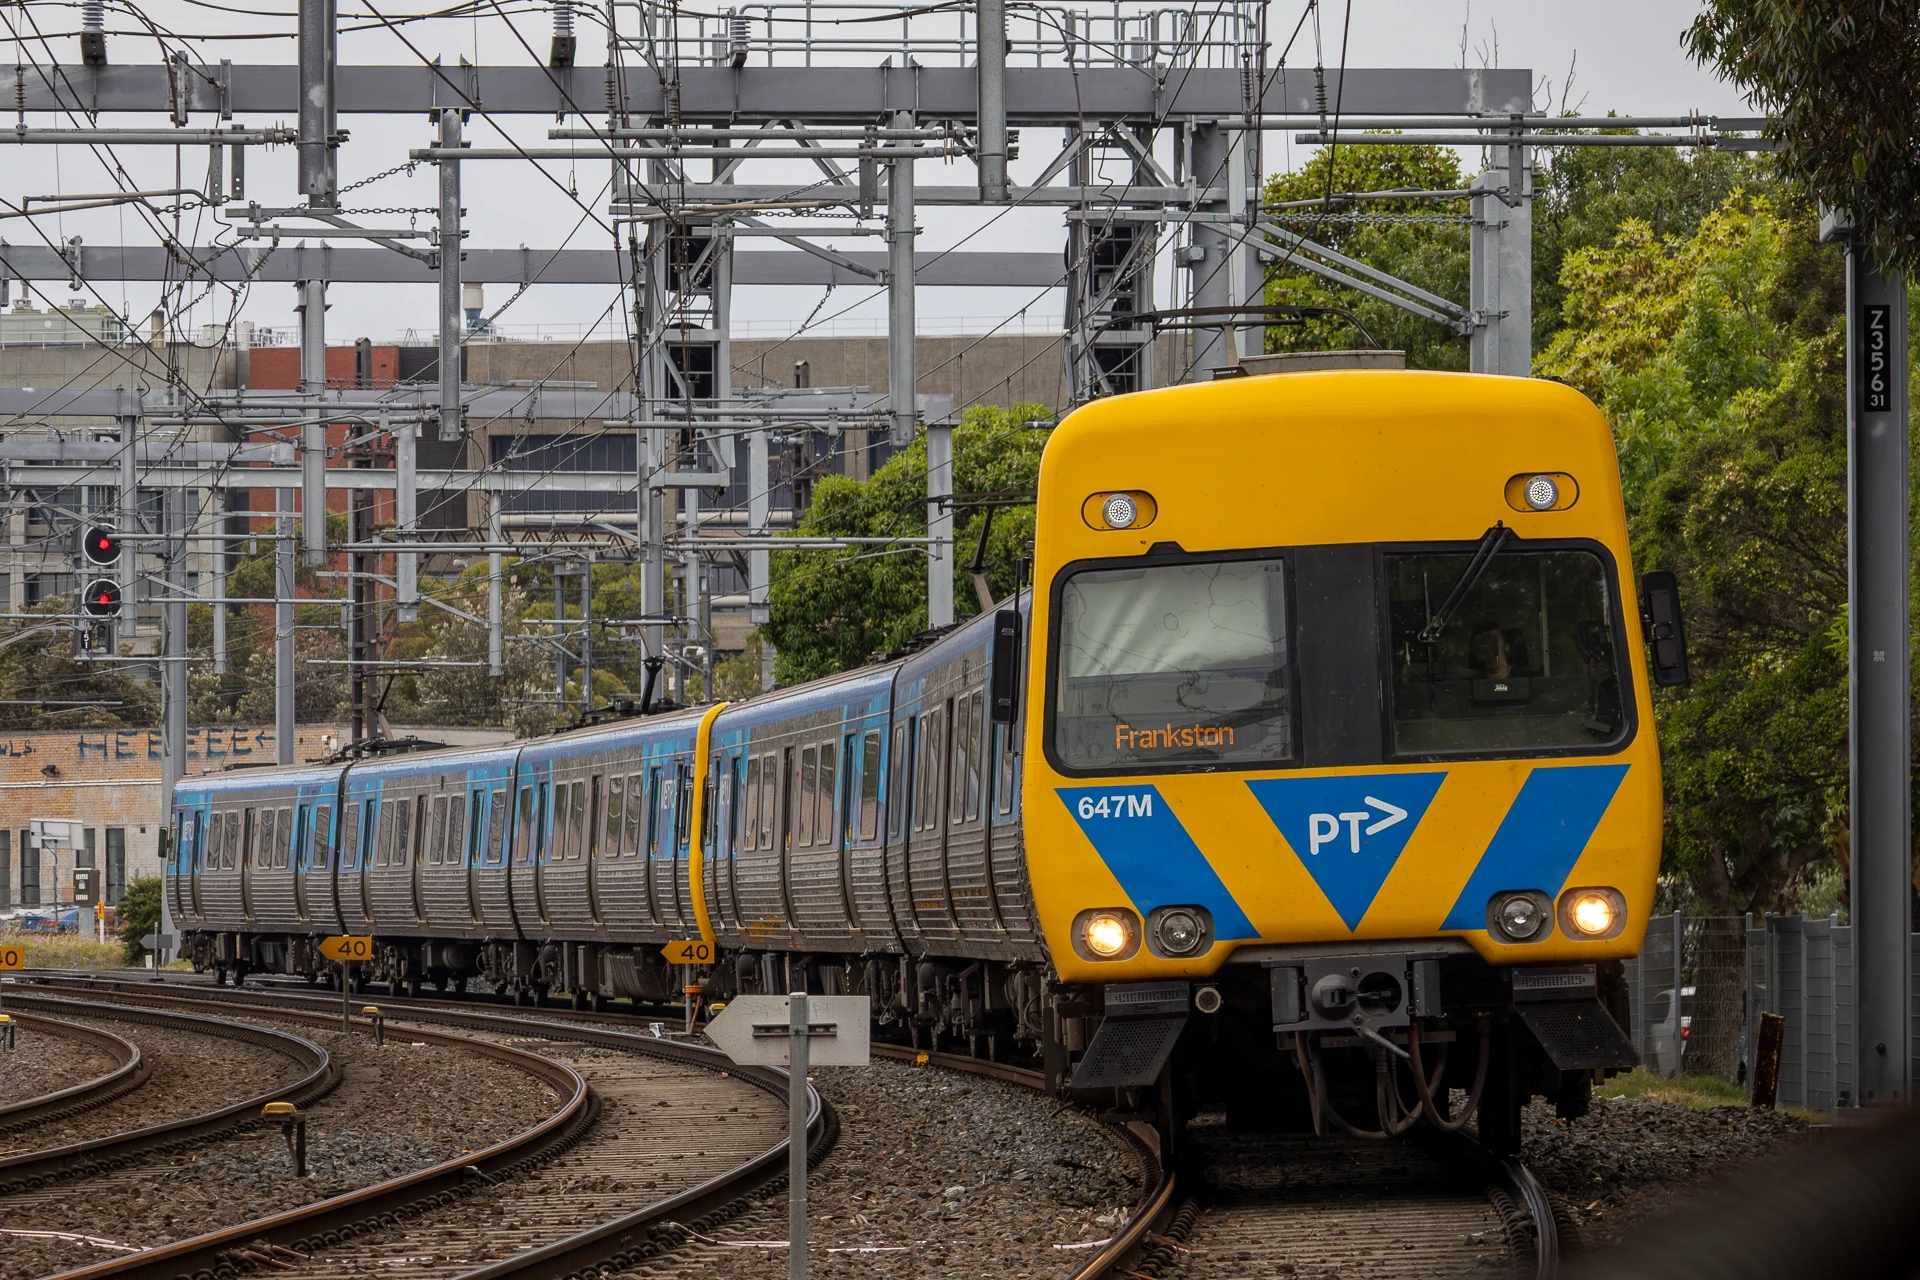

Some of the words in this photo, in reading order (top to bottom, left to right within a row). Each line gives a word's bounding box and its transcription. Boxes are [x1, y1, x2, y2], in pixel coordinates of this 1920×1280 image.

[1115, 724, 1234, 750] Frankston
[1077, 794, 1153, 820] 647M
[337, 940, 367, 956] 40
[680, 944, 709, 960] 40
